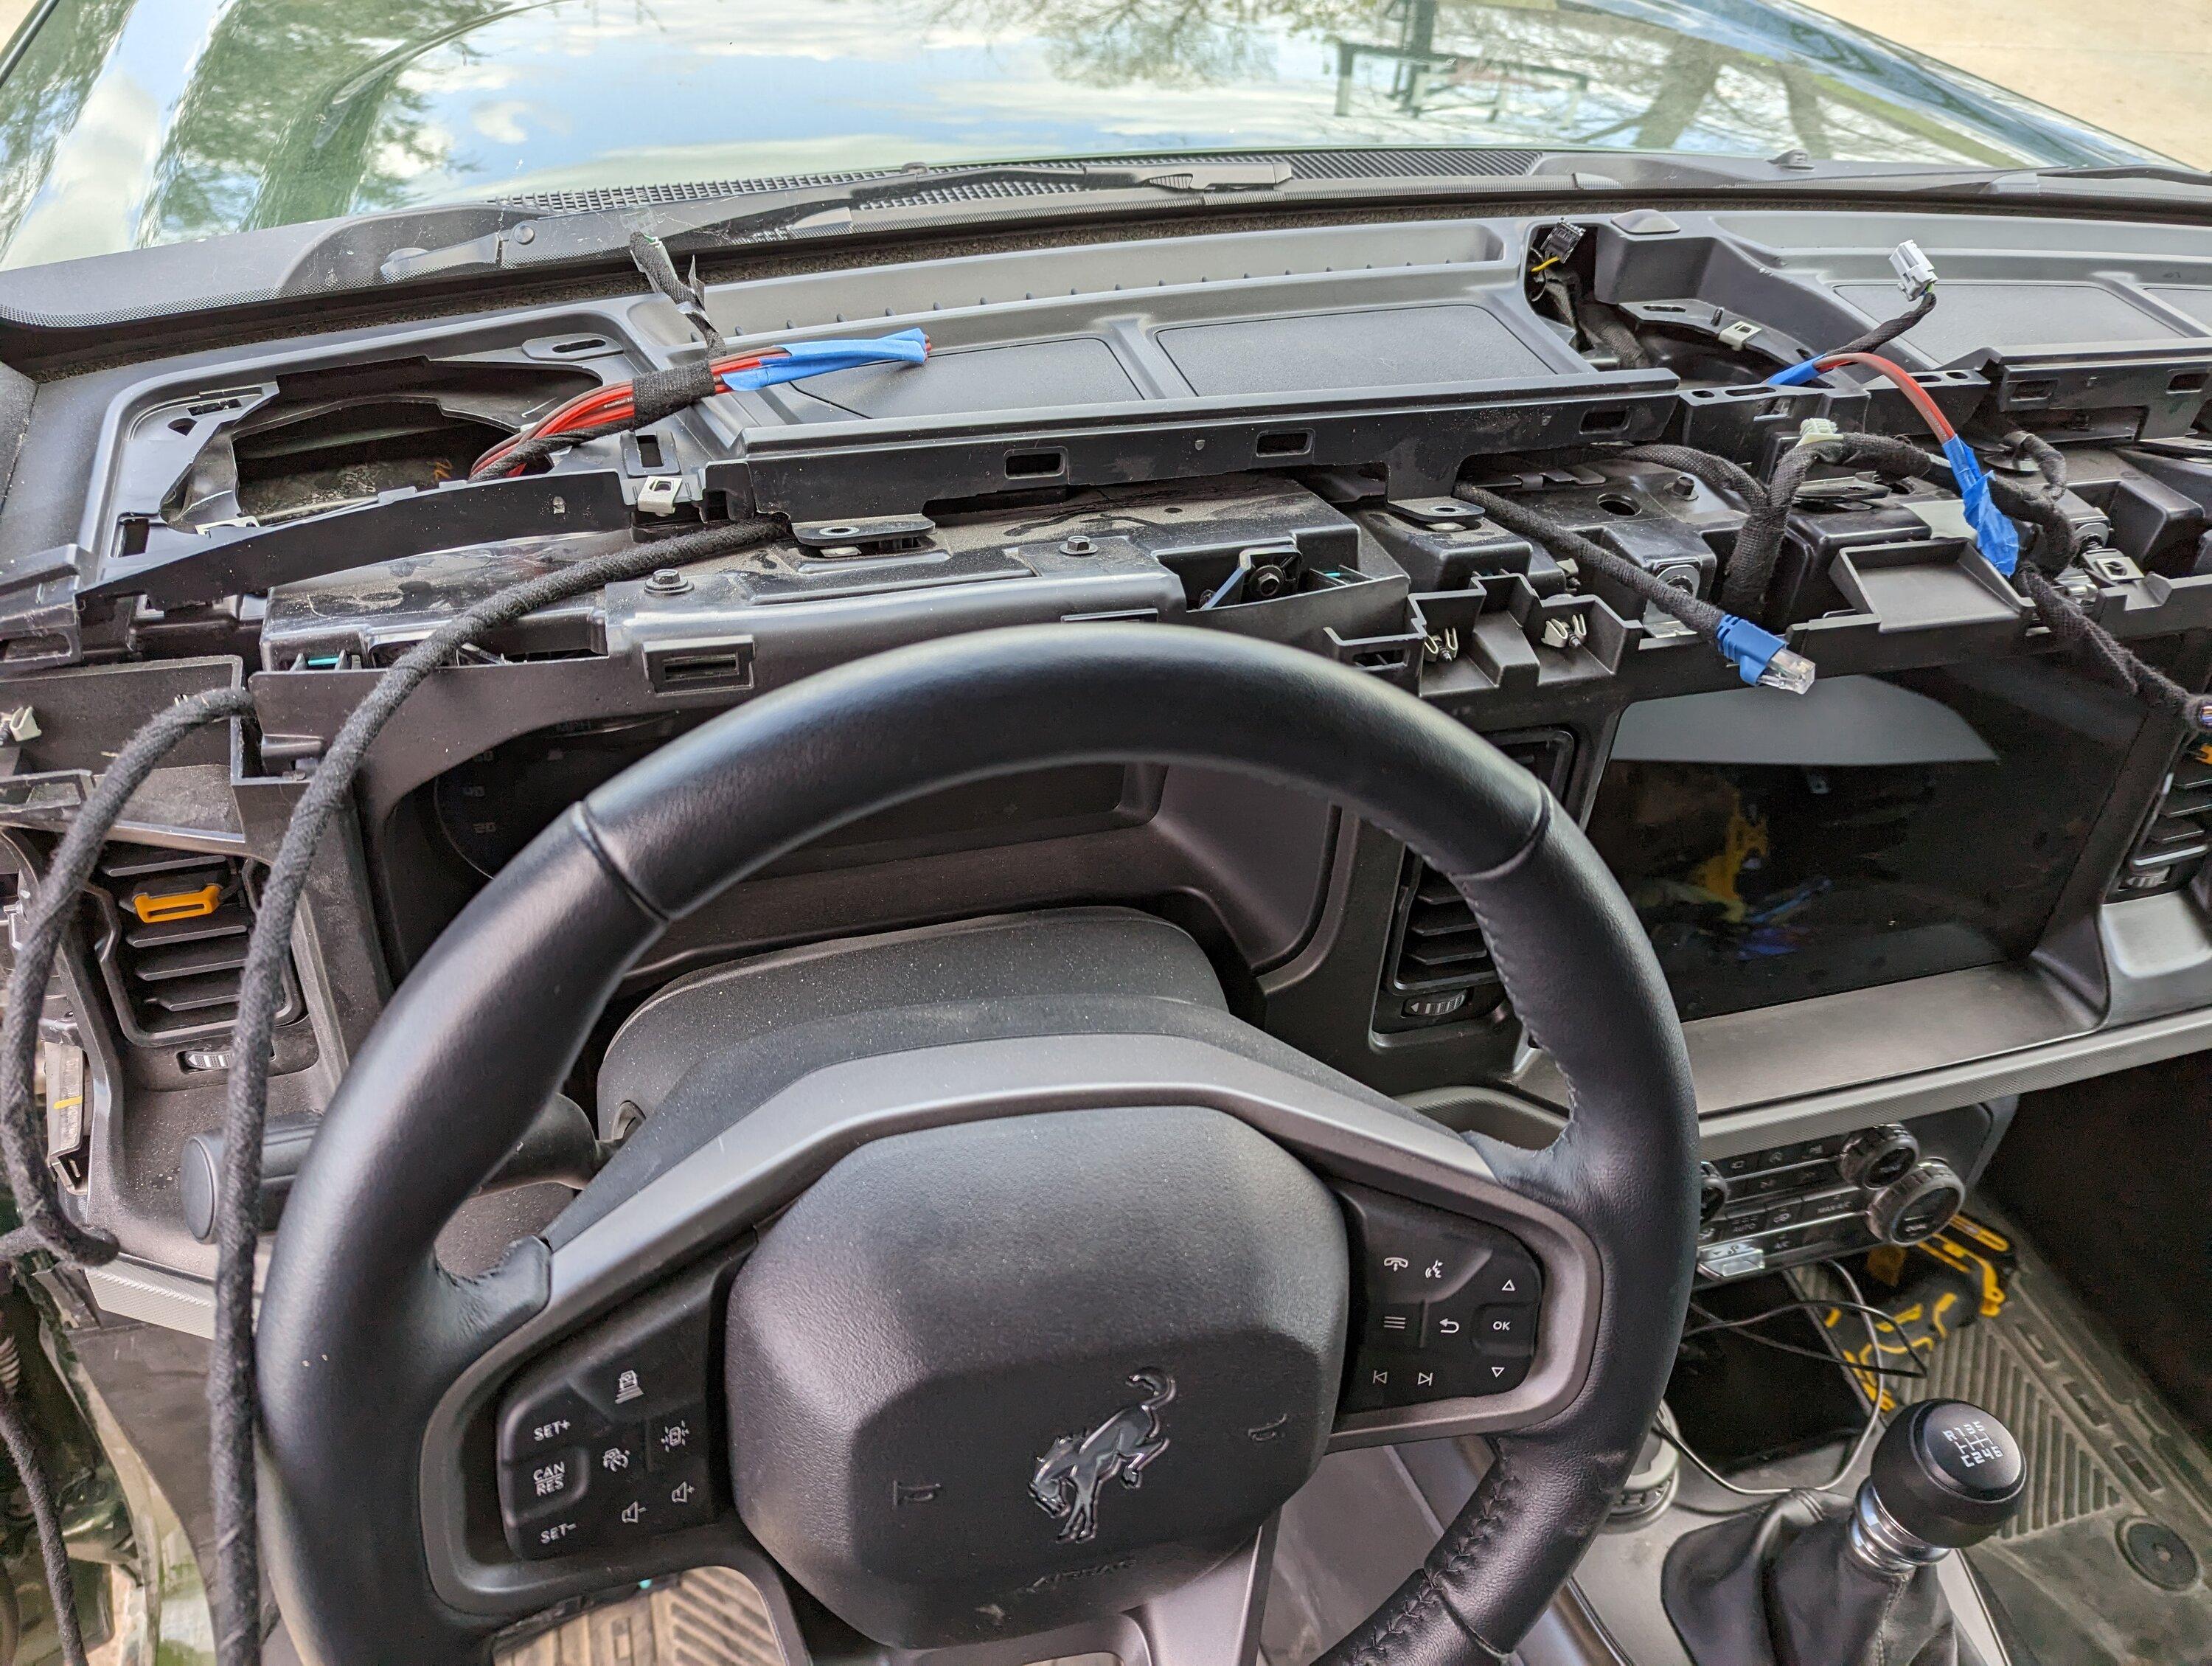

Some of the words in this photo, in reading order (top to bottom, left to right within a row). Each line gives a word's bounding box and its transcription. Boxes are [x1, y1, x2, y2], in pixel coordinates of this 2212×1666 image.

[1492, 1320, 1511, 1331] OK
[533, 1419, 571, 1441] SET+
[532, 1461, 566, 1481] CAN
[535, 1479, 565, 1496] RES
